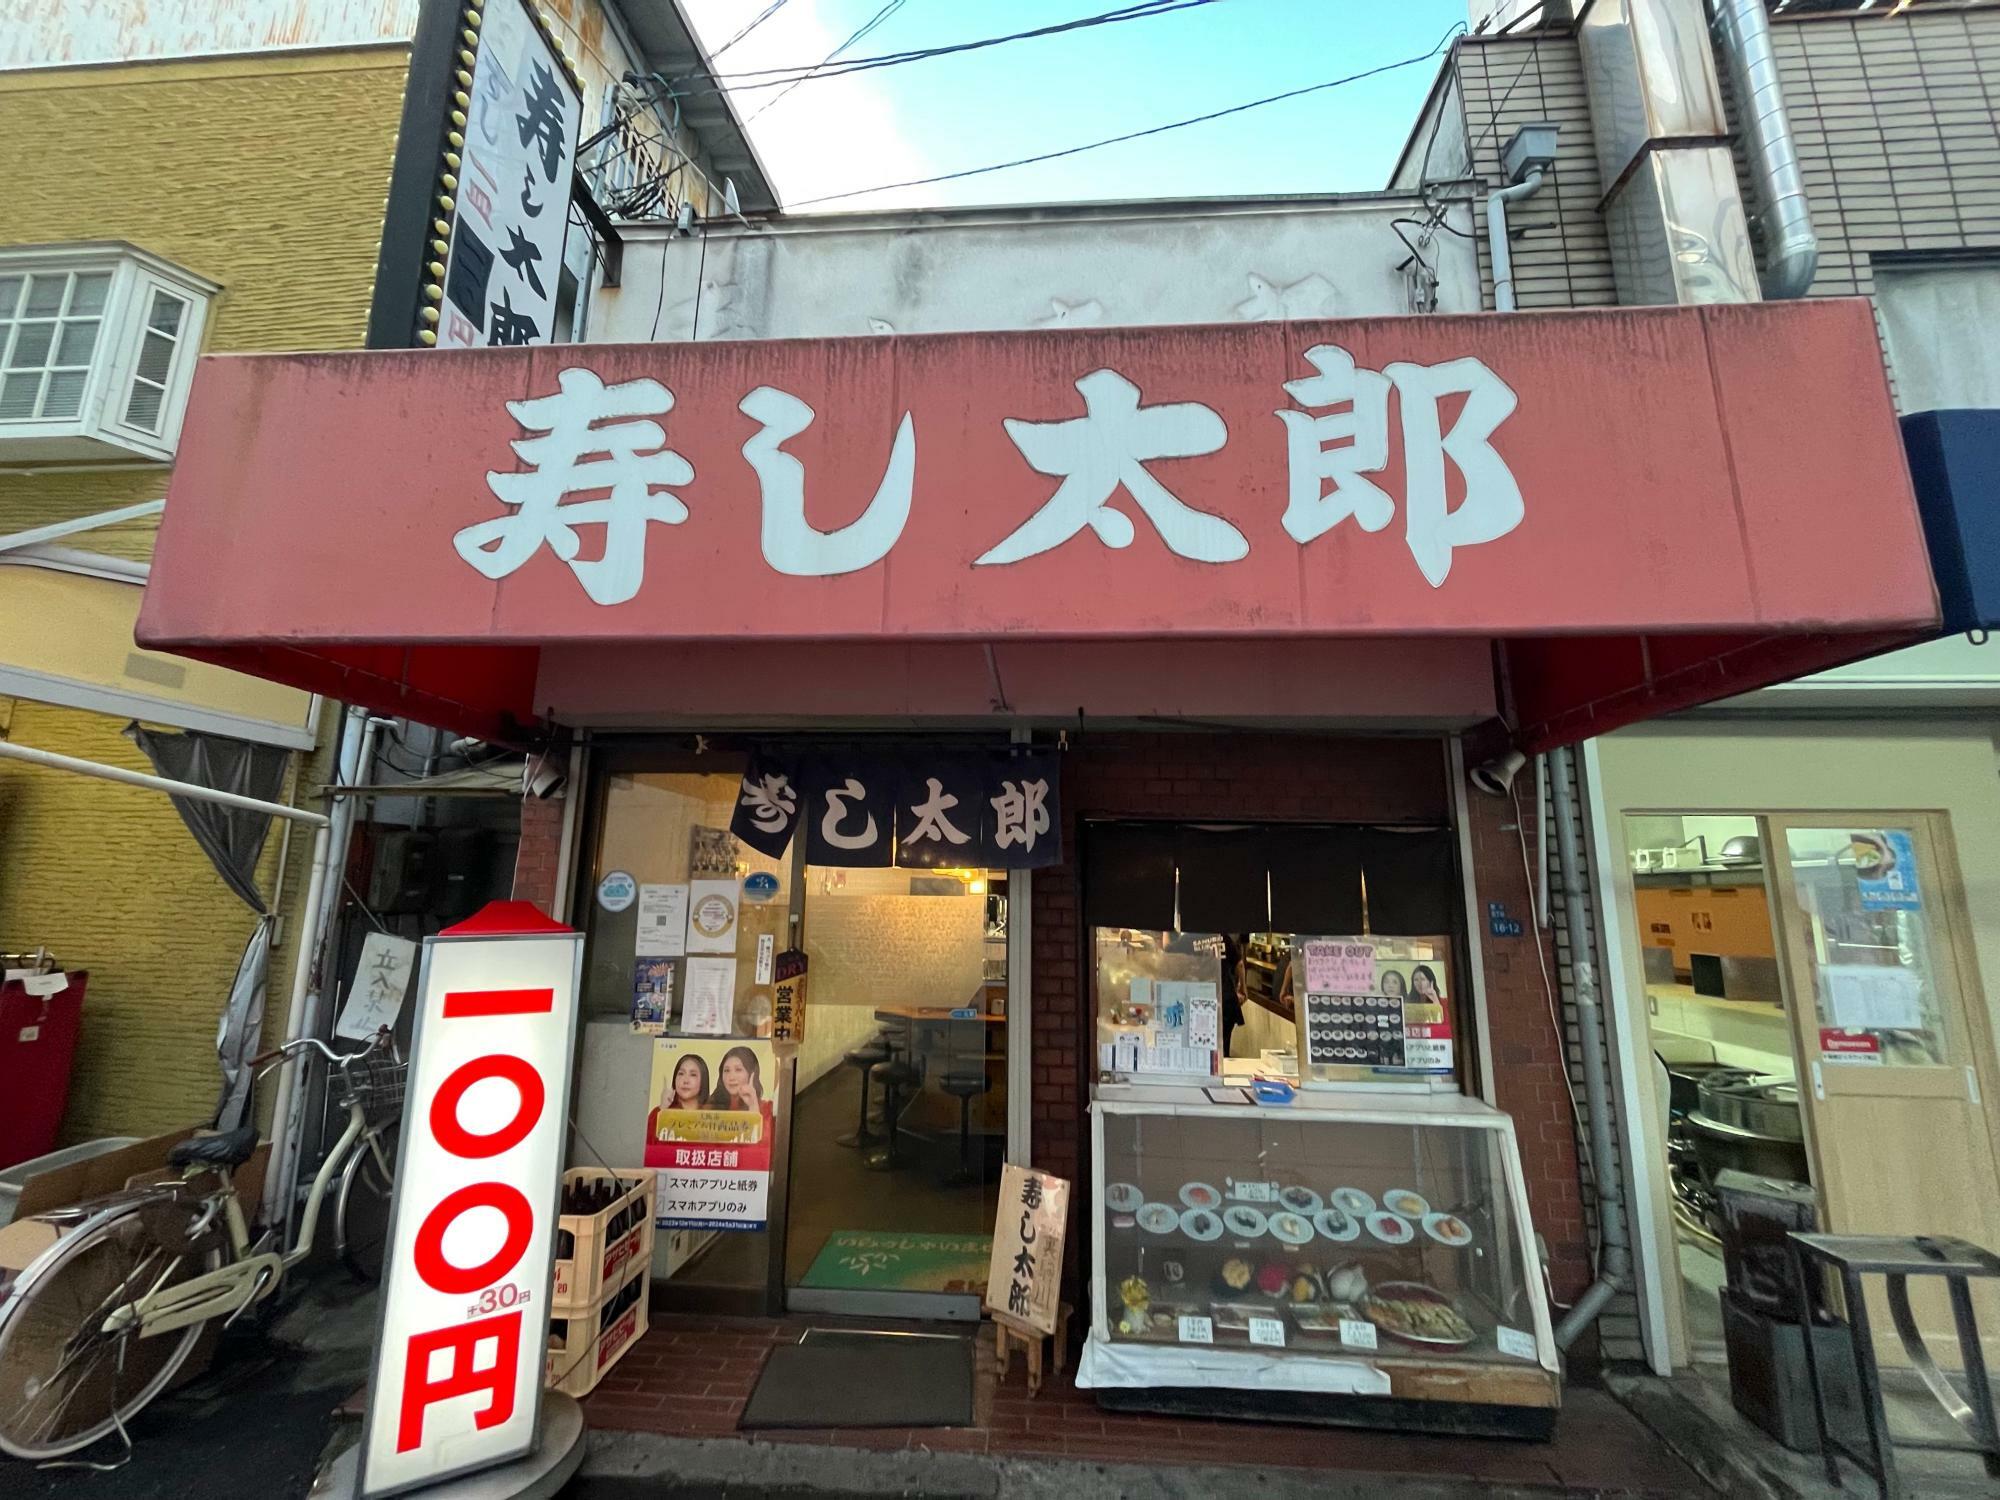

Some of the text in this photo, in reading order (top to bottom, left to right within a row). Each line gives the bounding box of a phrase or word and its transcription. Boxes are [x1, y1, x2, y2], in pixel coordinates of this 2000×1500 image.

[453, 343, 1525, 606] 寿し太郎
[1306, 945, 1373, 958] TAKE OUT
[349, 948, 398, 1032] 立入禁止
[774, 985, 794, 1042] 営業中
[675, 1149, 739, 1168] 取扱店舗
[669, 1177, 758, 1193] スマホアプリと紙券
[667, 1199, 748, 1213] スマホアプリのみ
[1008, 1176, 1043, 1318] 寿し太郎
[466, 1283, 531, 1318] +30円
